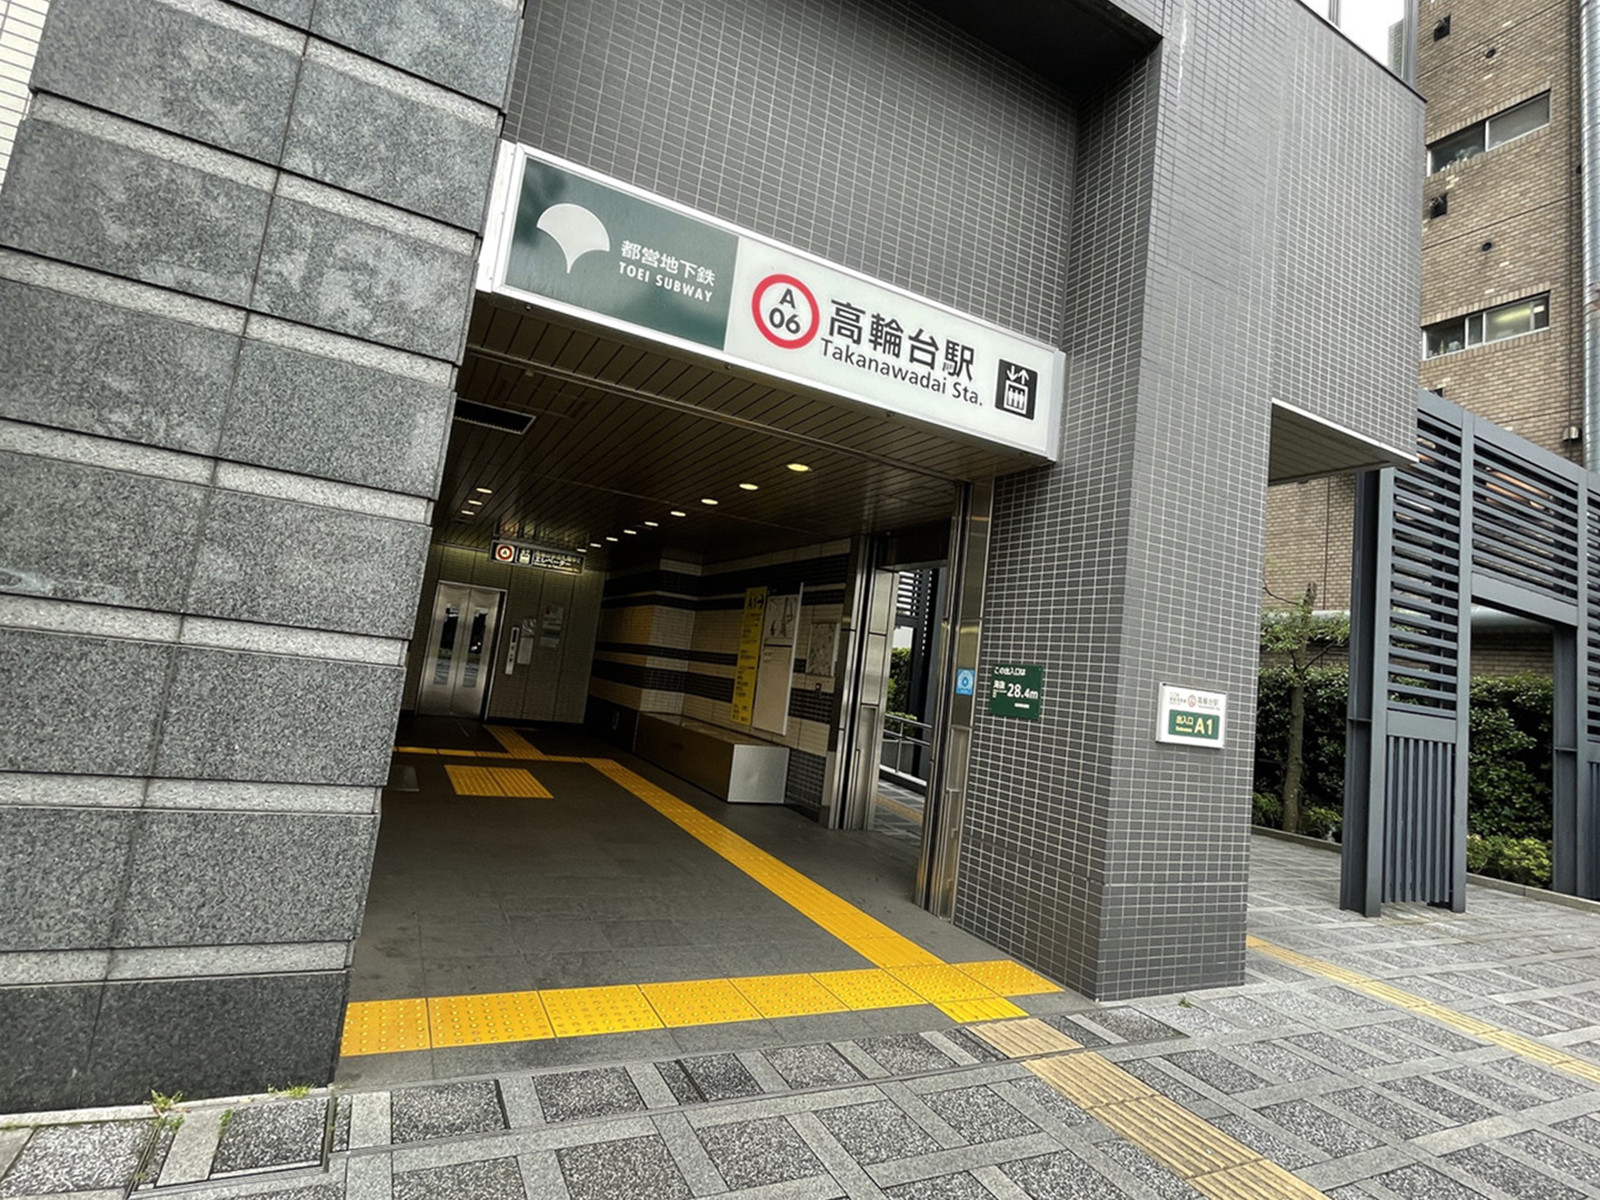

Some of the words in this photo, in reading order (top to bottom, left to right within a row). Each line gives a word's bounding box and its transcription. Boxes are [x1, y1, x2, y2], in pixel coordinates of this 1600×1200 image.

[620, 240, 715, 287] 都営地下鉄
[619, 261, 650, 283] TOEI
[655, 274, 713, 303] SUBWAY
[779, 288, 797, 310] A
[768, 307, 802, 336] 06
[828, 299, 976, 382] 高輪台駅
[820, 337, 947, 395] Takanawadai
[951, 381, 984, 407] Sta.
[1007, 683, 1039, 701] 28.4m
[1194, 717, 1213, 735] A1
